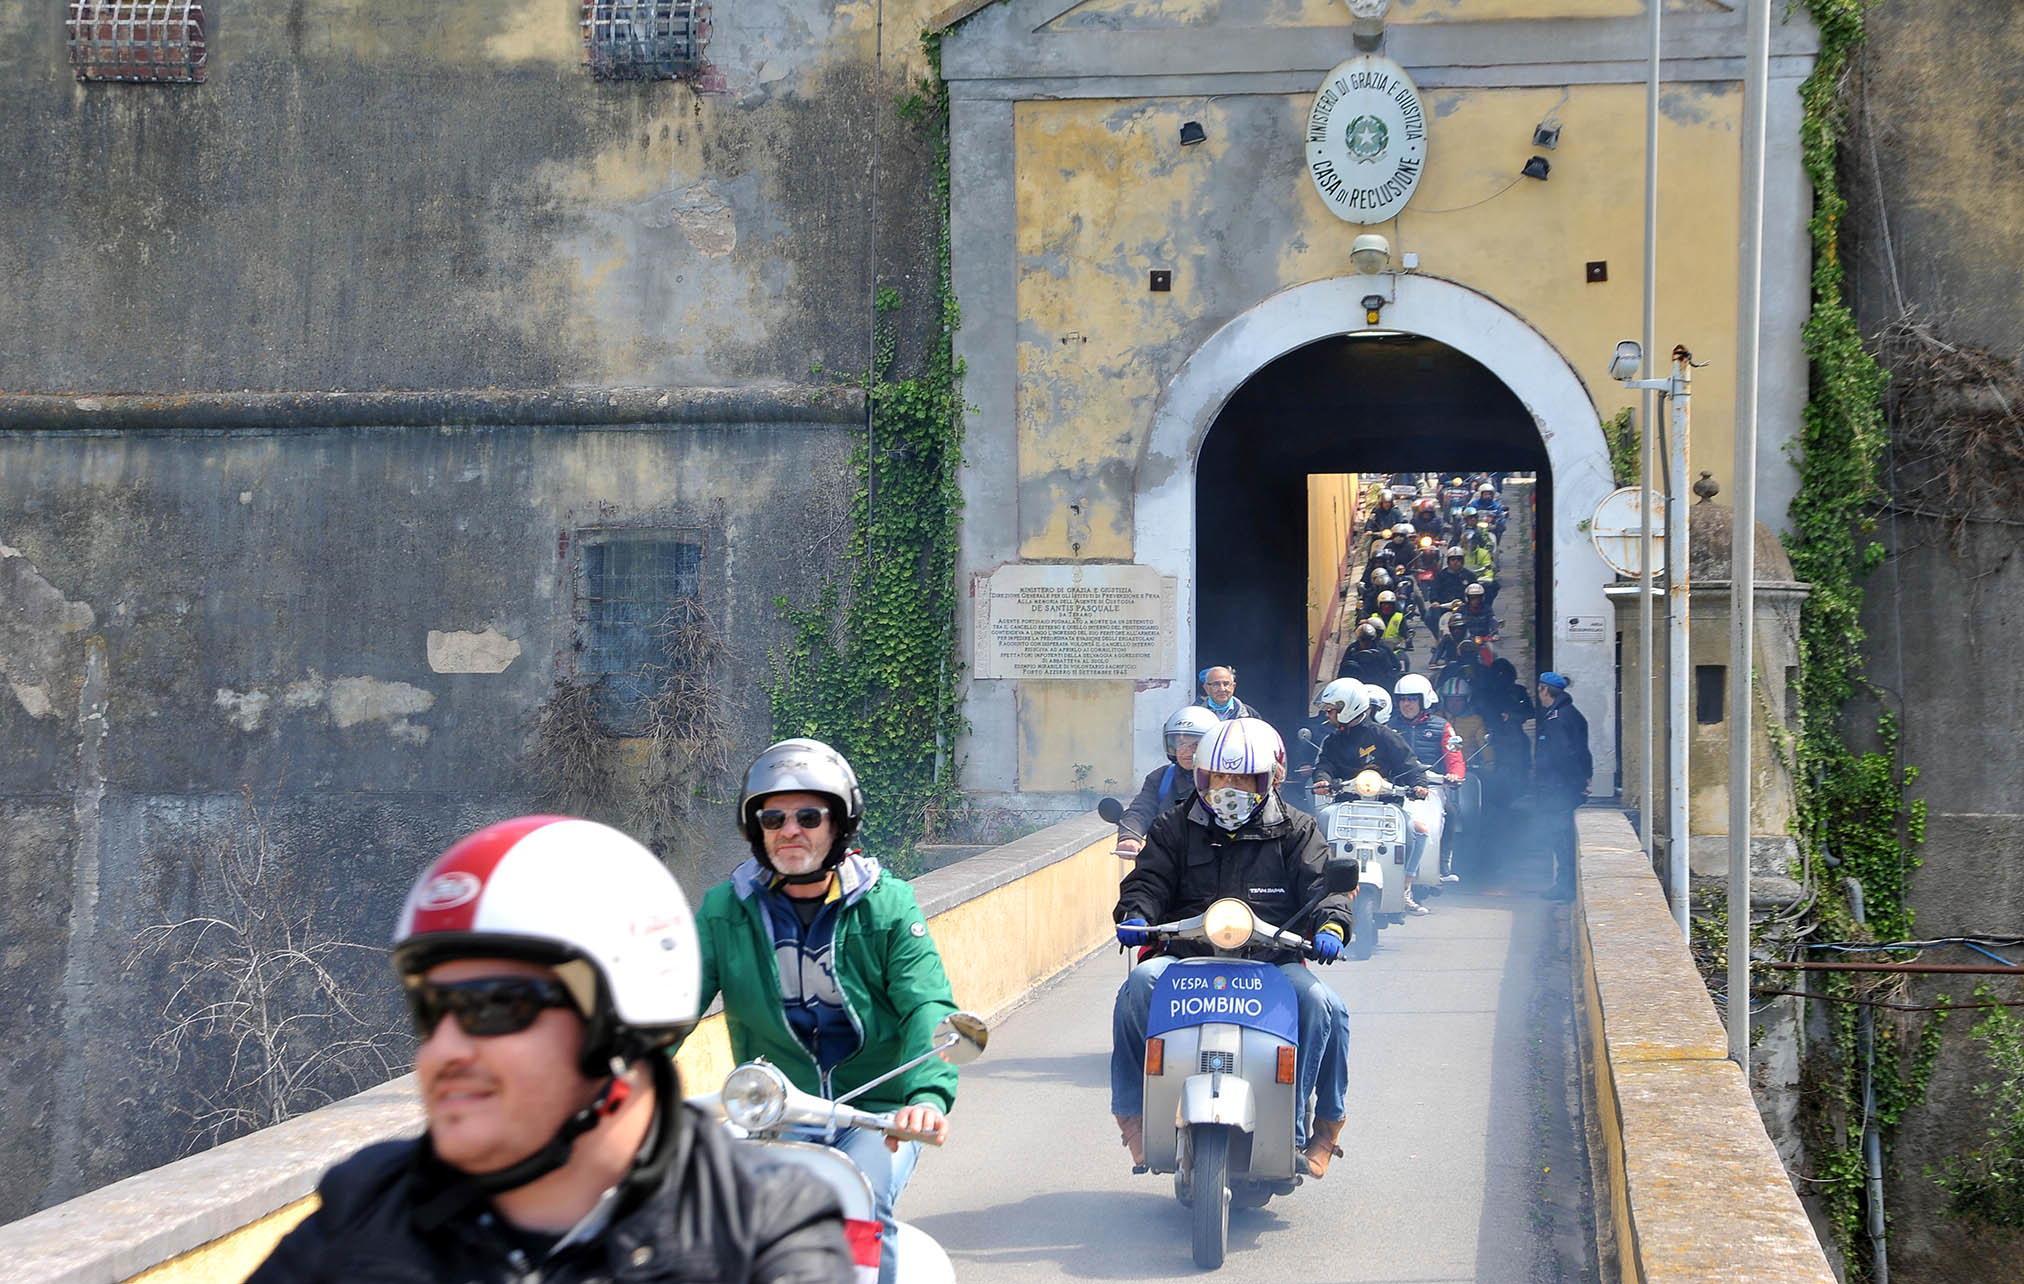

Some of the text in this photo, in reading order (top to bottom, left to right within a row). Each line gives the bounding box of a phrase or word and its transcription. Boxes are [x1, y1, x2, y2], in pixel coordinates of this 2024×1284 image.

[1310, 71, 1423, 143] MINISTERO DI GRAZIA E GIUSTIZIA
[1312, 157, 1421, 210] CASA DI RECLUSIONE
[1172, 977, 1263, 990] VESPA CLUB
[1170, 996, 1263, 1018] PIOMBINO
